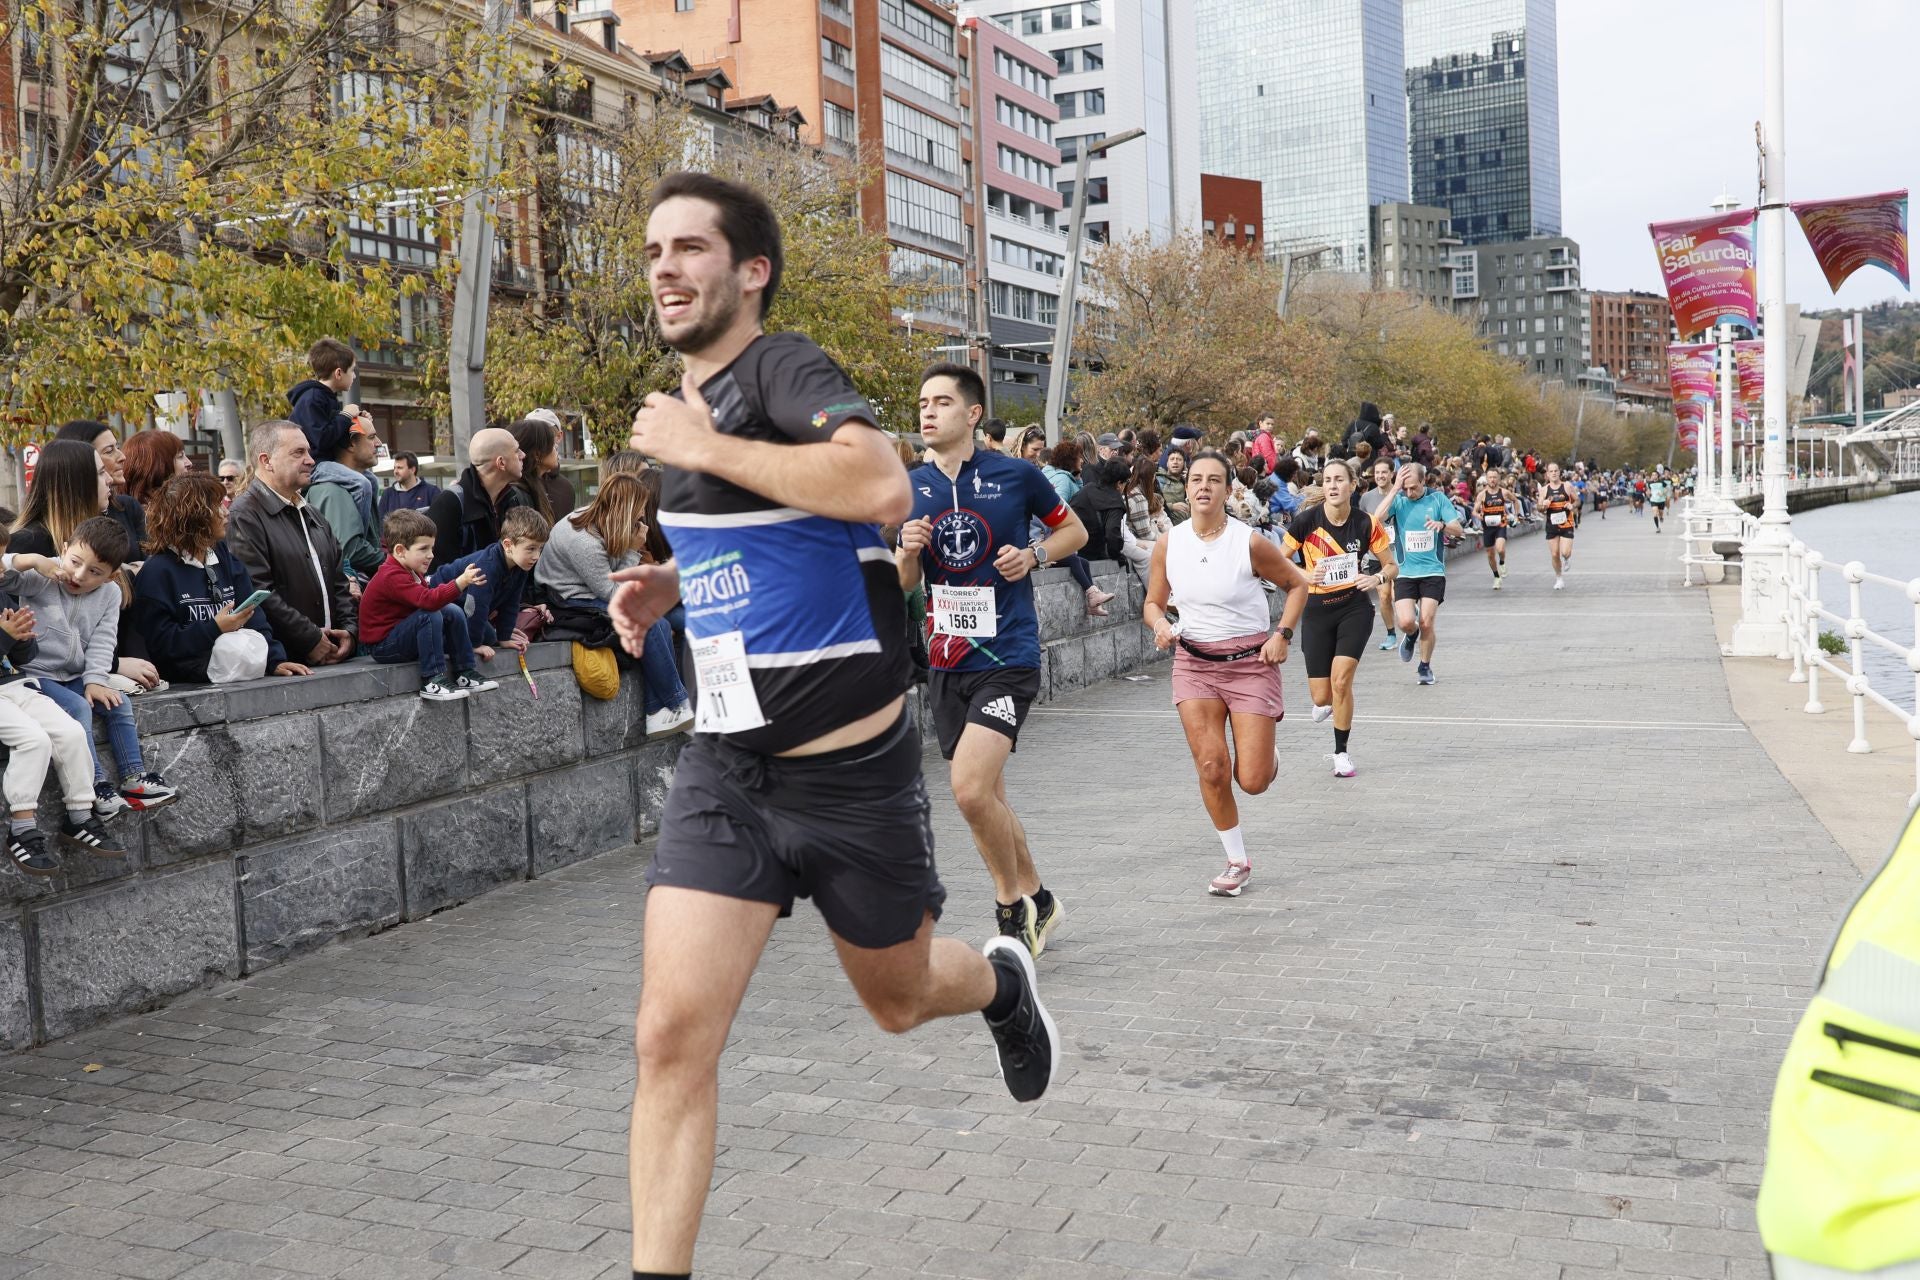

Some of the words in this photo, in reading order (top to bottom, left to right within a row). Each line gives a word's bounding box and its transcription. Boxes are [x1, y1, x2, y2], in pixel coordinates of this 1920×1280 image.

[1660, 234, 1696, 257] Fair
[1664, 244, 1753, 273] Saturday
[1670, 353, 1688, 361] Fair
[1671, 359, 1715, 371] Saturday
[1329, 569, 1348, 581] 1168
[937, 599, 958, 611] XXXVI
[949, 613, 977, 630] 1563
[981, 706, 1017, 726] adidas
